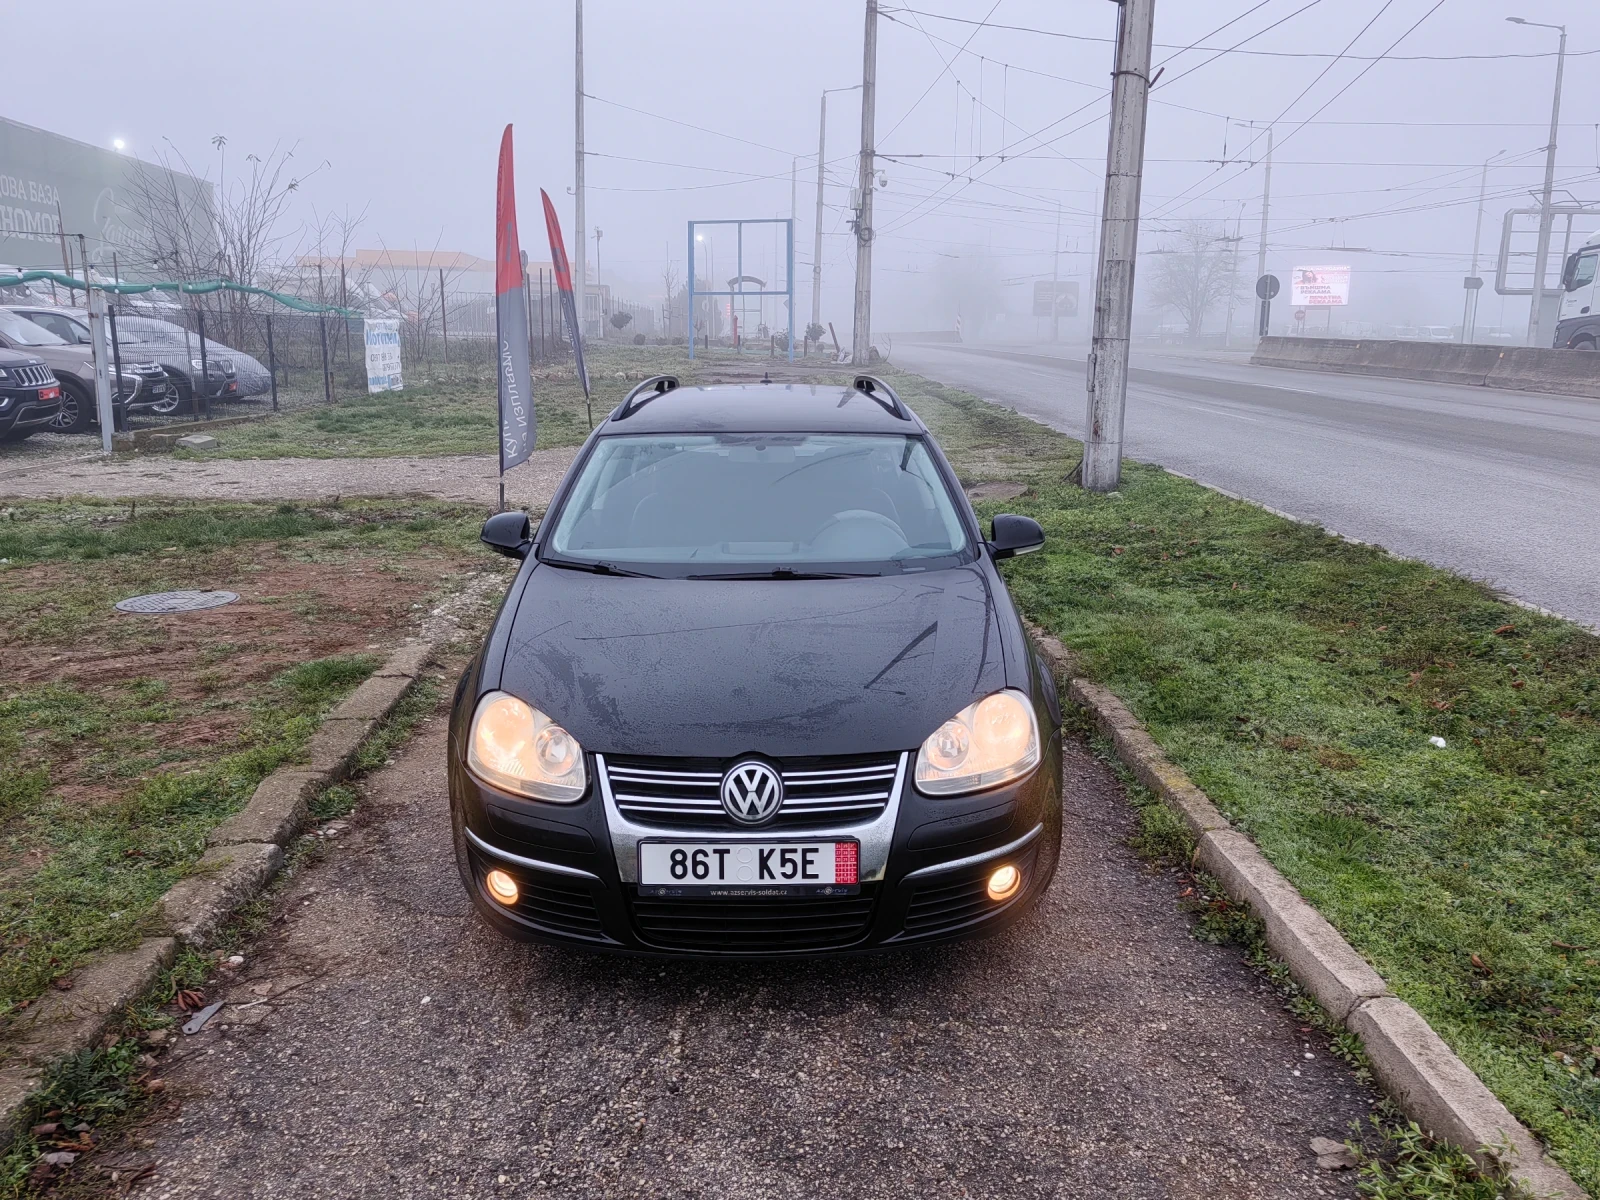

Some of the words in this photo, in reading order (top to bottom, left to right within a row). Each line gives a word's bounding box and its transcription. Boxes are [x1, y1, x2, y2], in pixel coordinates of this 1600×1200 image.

[28, 181, 61, 206] БАЗА
[724, 764, 780, 820] VW
[670, 848, 731, 880] 86T
[758, 848, 820, 880] K5E
